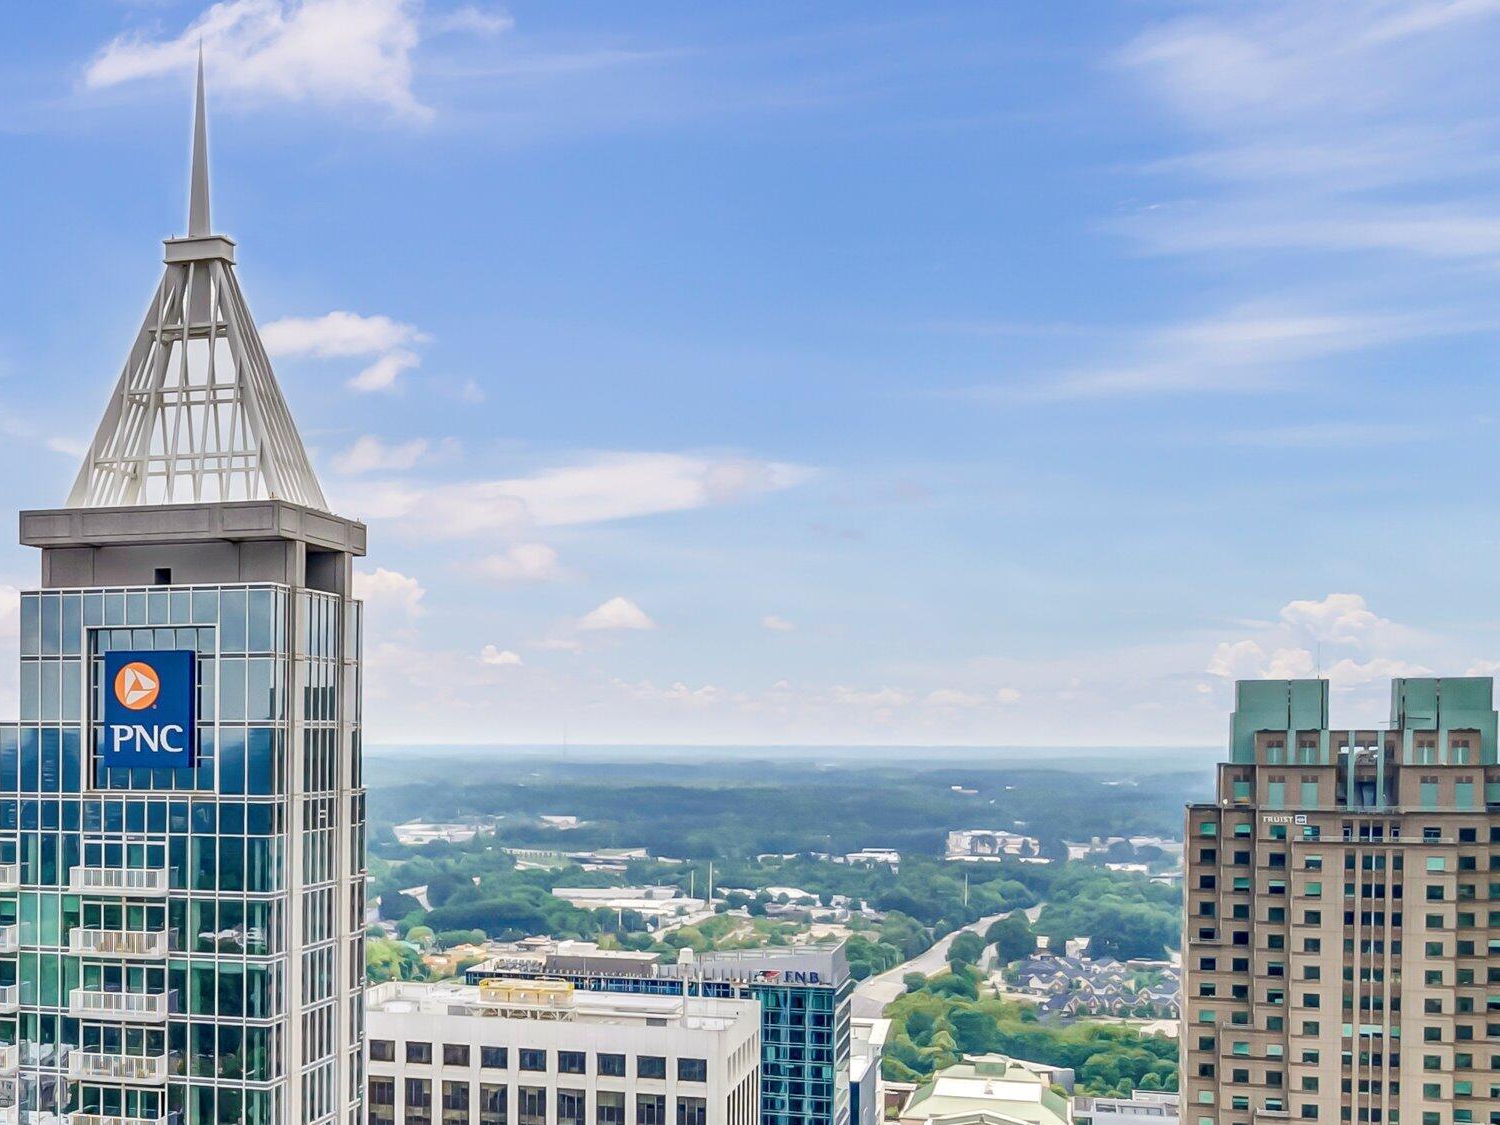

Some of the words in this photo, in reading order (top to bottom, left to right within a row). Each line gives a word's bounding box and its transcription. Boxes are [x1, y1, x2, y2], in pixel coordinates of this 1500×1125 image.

[110, 725, 183, 753] PNC
[1262, 815, 1293, 823] TRUIST
[783, 970, 819, 984] FNB
